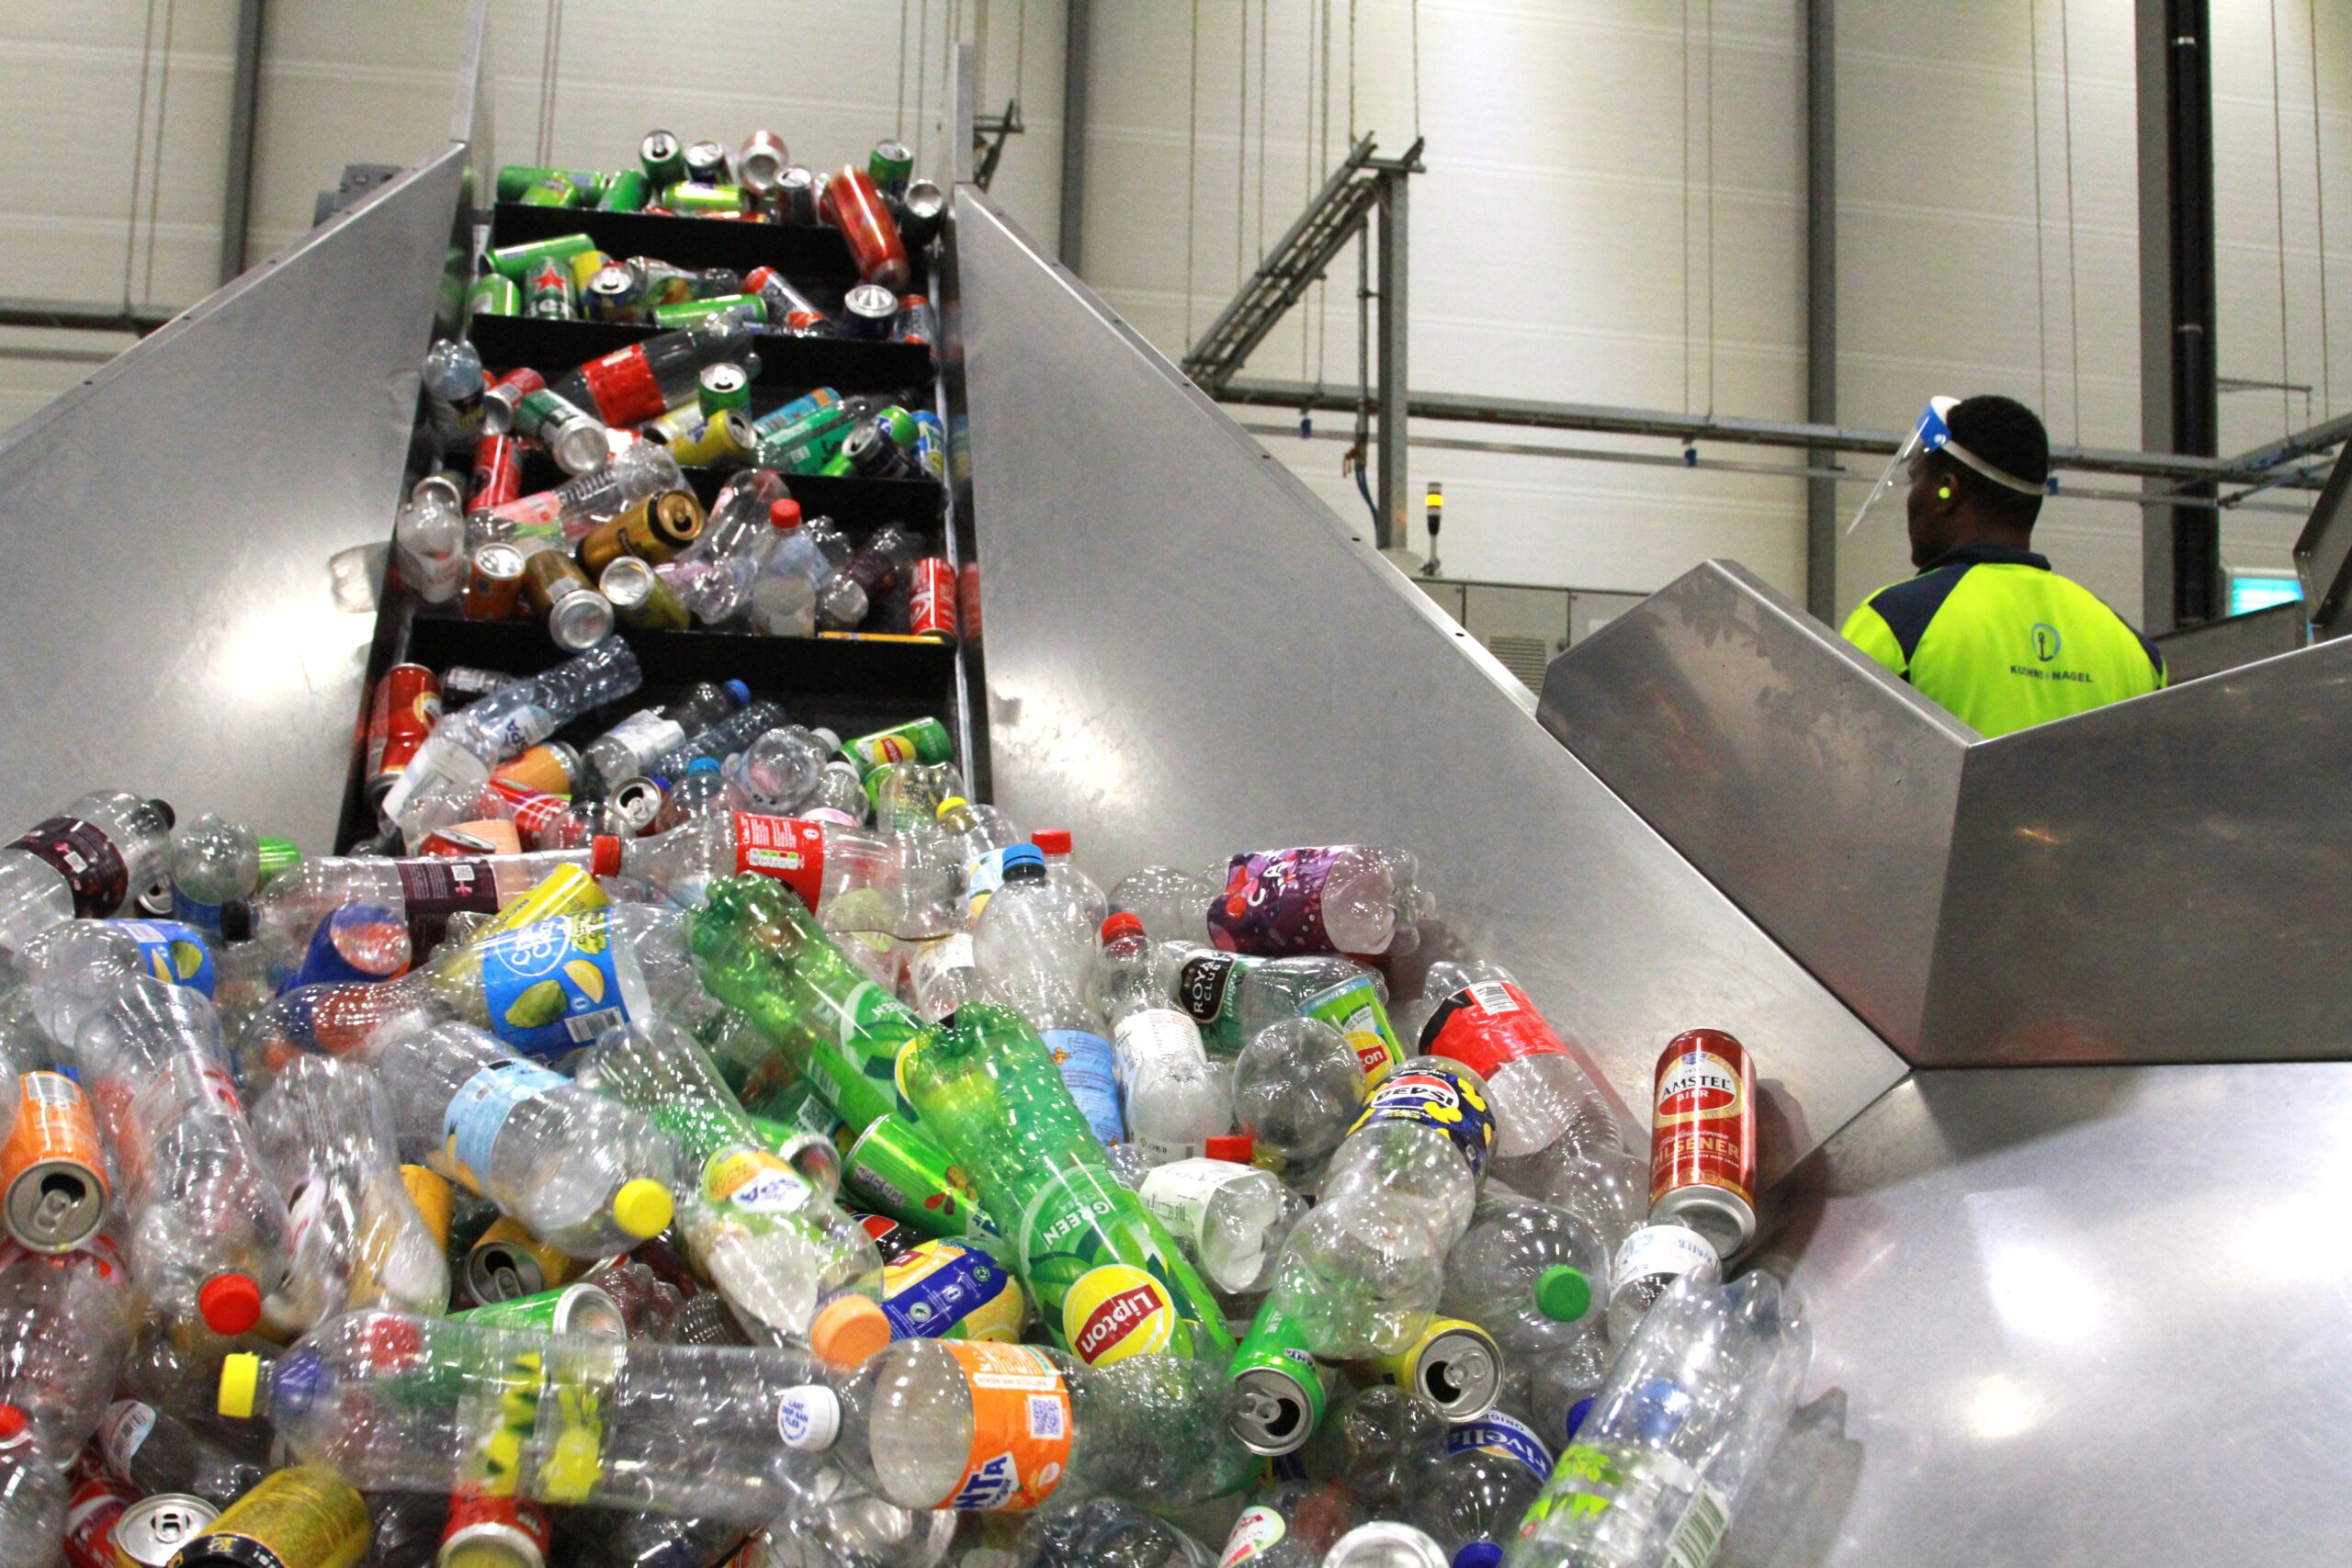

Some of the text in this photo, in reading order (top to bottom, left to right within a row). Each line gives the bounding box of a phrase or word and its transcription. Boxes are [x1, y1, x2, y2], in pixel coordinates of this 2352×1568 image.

[2052, 671, 2093, 683] NAGEL
[1204, 963, 1221, 1001] CLUB
[1376, 1087, 1454, 1106] PEPSI
[1662, 1076, 1730, 1100] AMSTEL
[1677, 1089, 1709, 1102] BIER
[1654, 1137, 1740, 1165] PILSENER
[1042, 1200, 1112, 1246] GREEN
[1080, 1291, 1156, 1354] Lipton
[952, 1456, 1008, 1509] NTA
